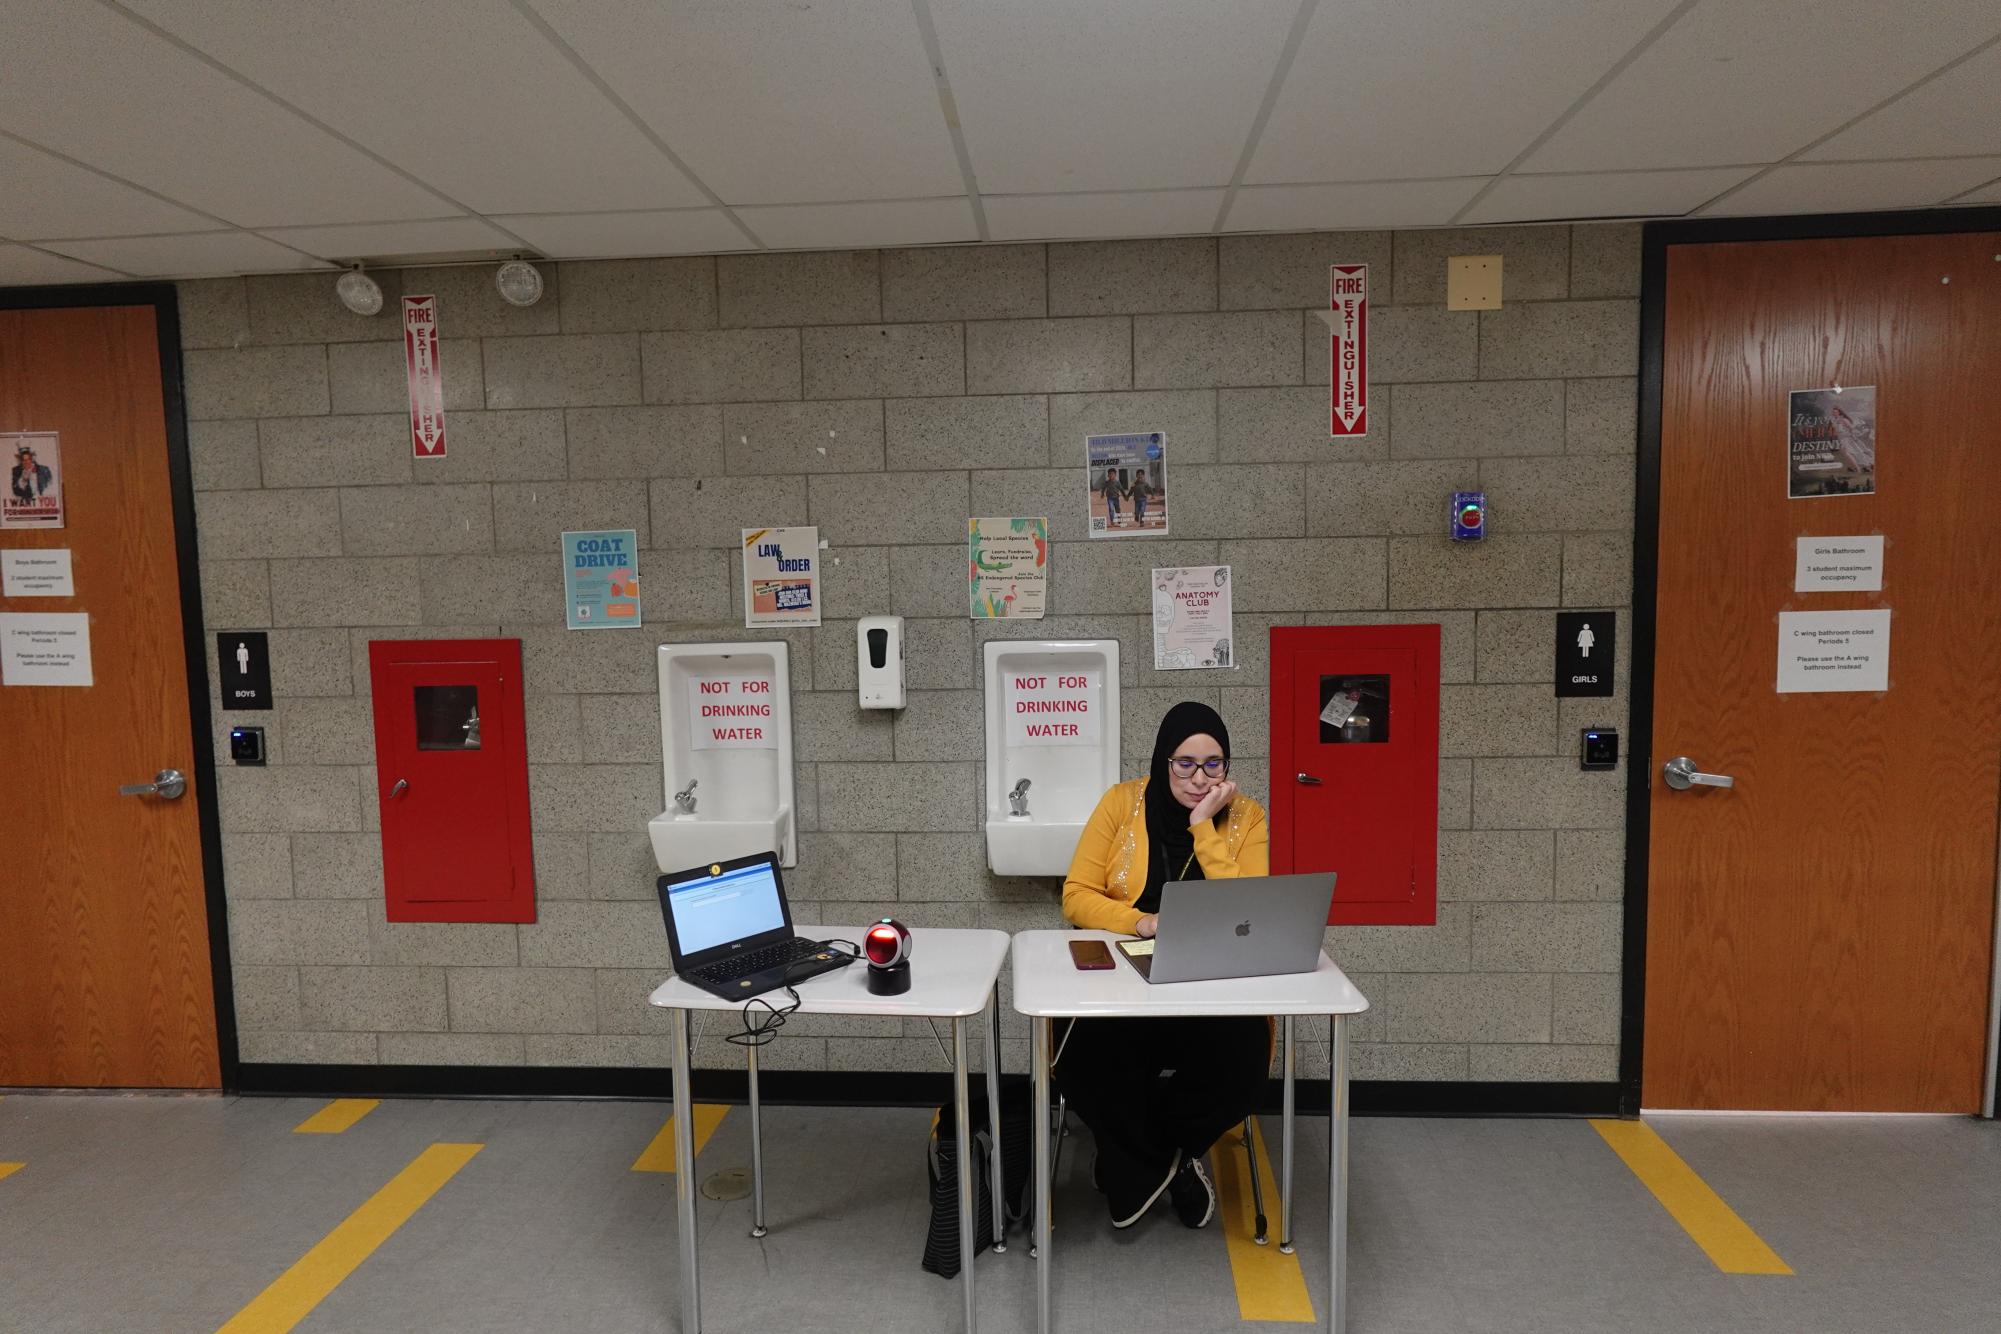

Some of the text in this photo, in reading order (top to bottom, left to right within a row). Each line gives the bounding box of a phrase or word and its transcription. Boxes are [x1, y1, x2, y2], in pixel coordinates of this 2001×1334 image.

[1336, 278, 1363, 294] FIRE
[408, 308, 432, 324] FIRE
[1344, 300, 1355, 420] EXTINGUISHER
[416, 328, 434, 442] EXTINGSHER
[1792, 440, 1841, 452] DESTINY
[38, 496, 56, 507] YOU
[576, 539, 623, 553] COAT
[758, 544, 780, 557] LAW
[574, 554, 627, 568] DRIVE
[776, 551, 783, 562] &
[778, 558, 810, 572] ORDER
[1176, 591, 1220, 599] ANATOMY
[700, 681, 769, 694] NOT FOR
[1016, 676, 1087, 689] NOT FOR
[702, 704, 770, 716] DRINKING
[1016, 700, 1088, 713] DRINKING
[712, 728, 762, 740] WATER
[1026, 724, 1078, 736] WATER
